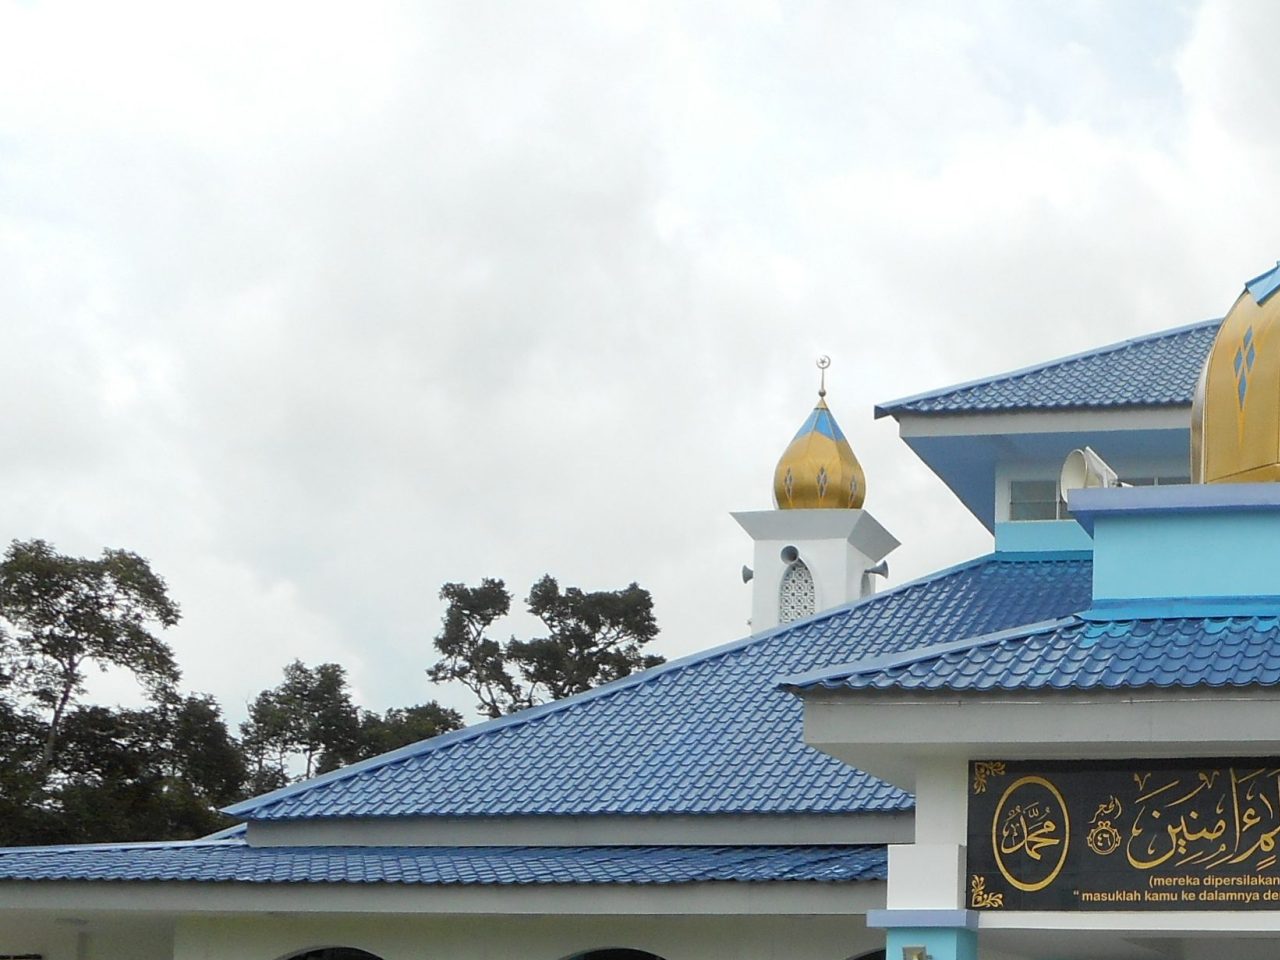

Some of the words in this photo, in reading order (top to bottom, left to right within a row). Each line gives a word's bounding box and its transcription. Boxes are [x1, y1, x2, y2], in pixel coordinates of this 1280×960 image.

[1149, 874, 1200, 888] (mereka
[1203, 874, 1280, 888] dipersilakan
[1144, 890, 1178, 902] kamu
[1181, 890, 1196, 901] ke
[1199, 889, 1260, 904] dalamnya
